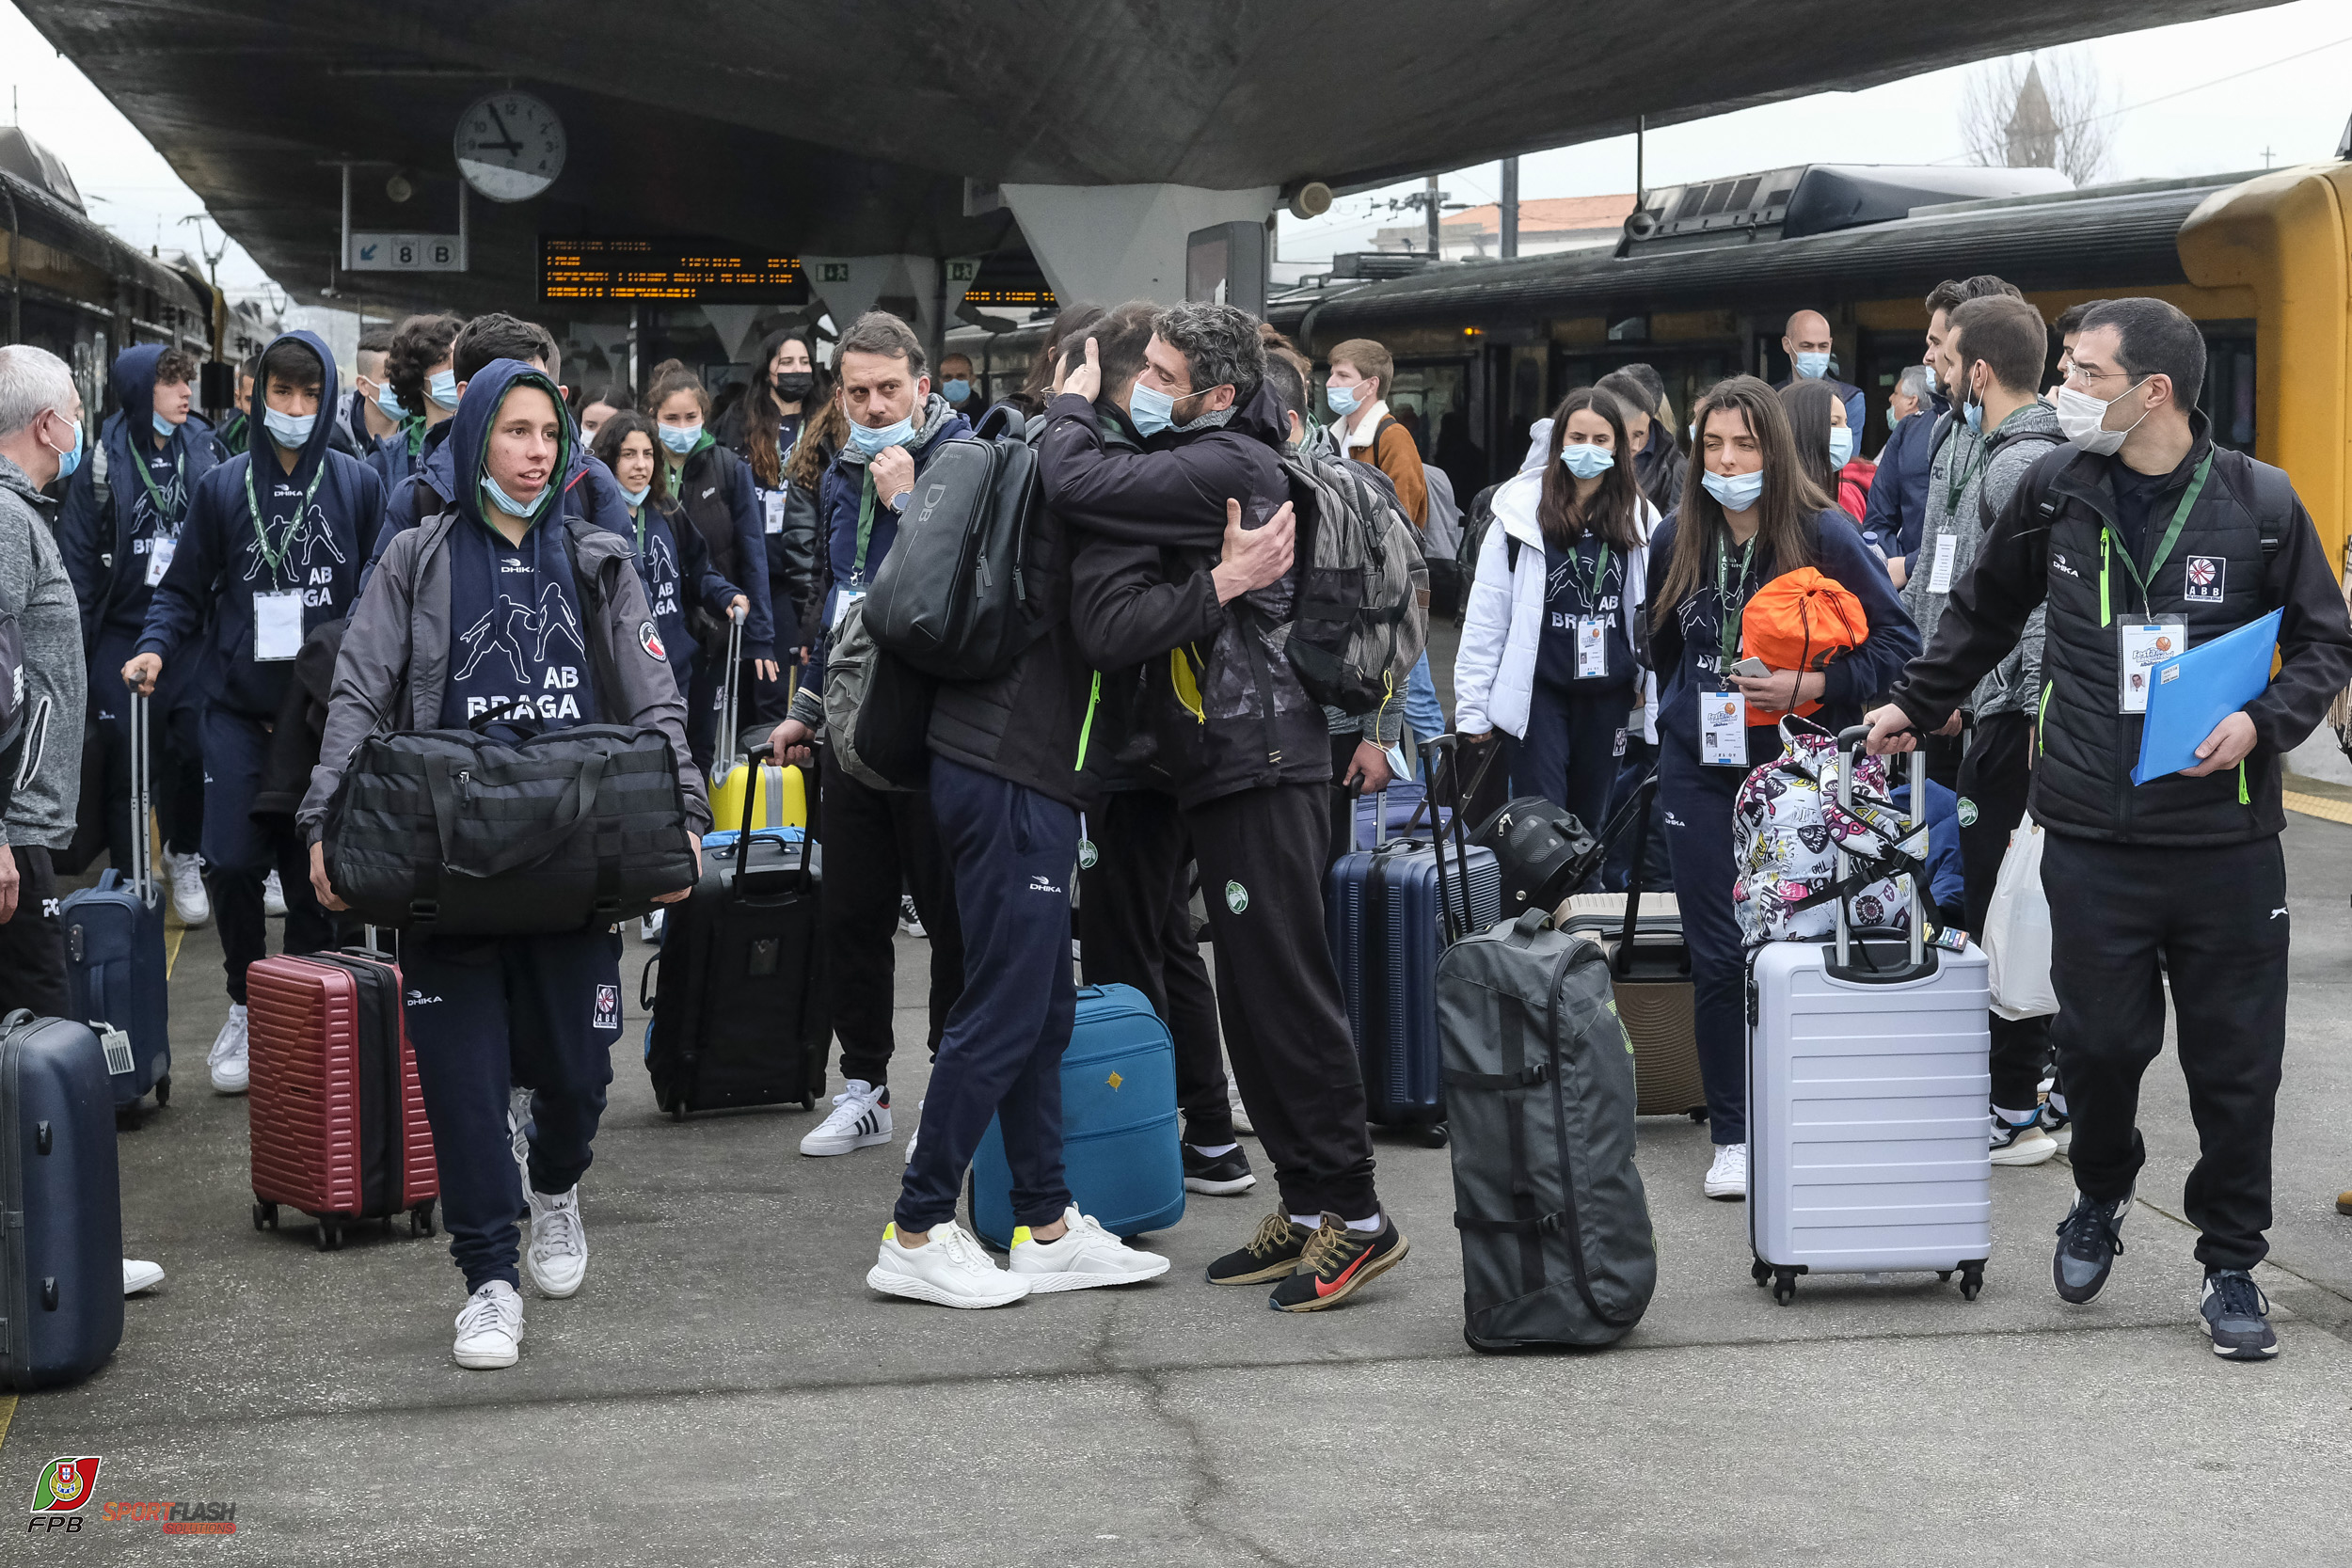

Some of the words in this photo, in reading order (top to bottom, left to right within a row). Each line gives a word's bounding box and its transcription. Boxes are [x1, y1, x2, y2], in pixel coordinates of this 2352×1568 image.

[504, 102, 516, 115] 12
[473, 120, 487, 134] 10
[400, 246, 412, 262] 8
[435, 246, 449, 262] B
[918, 483, 947, 523] DB
[309, 566, 333, 586] AB
[2053, 561, 2080, 578] DHIKA
[659, 581, 675, 599] AB
[1598, 595, 1619, 611] AB
[543, 666, 580, 689] AB
[467, 693, 581, 721] BRAGA
[1029, 883, 1061, 894] DHIKA
[406, 995, 443, 1006] DHIKA
